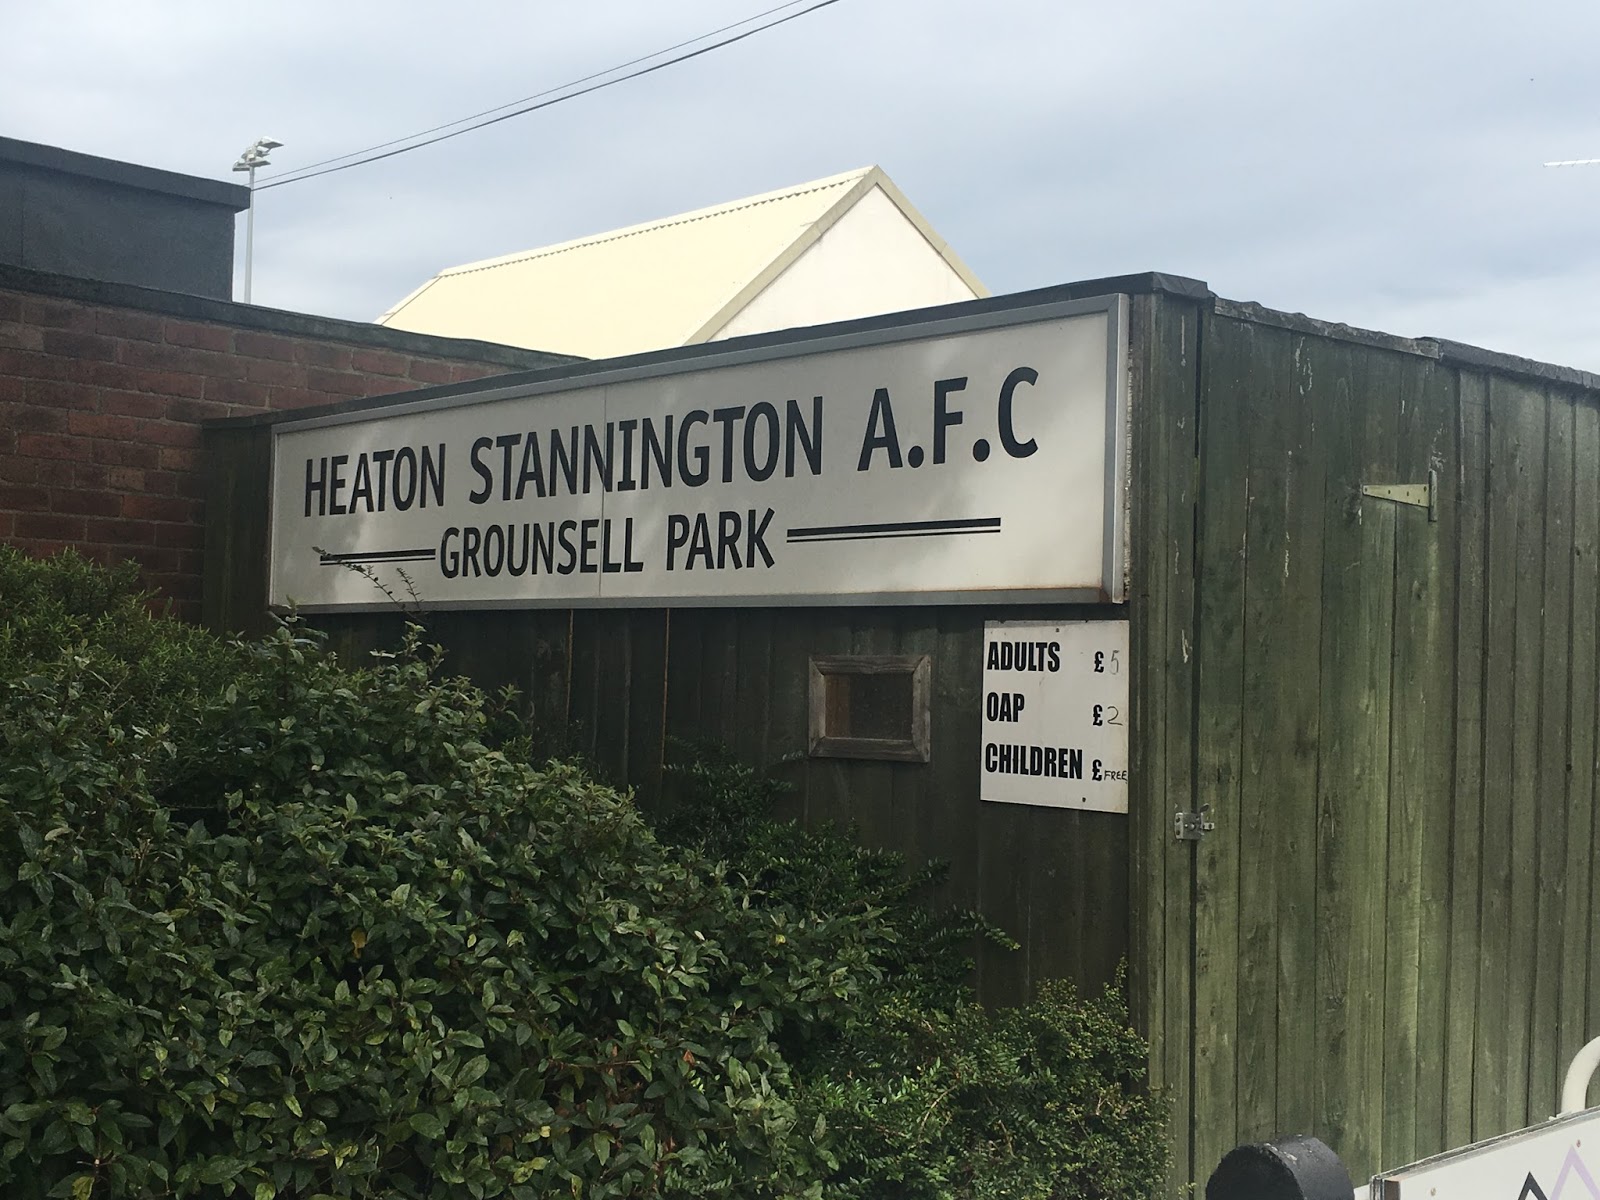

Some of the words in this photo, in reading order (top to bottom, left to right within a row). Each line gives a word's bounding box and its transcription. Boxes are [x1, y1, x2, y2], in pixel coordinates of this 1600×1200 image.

[304, 443, 446, 517] HEATON
[469, 396, 823, 504] STANNINGTON
[857, 366, 1039, 471] A.F.C
[440, 517, 643, 578] GROUNSELL
[666, 507, 775, 571] PARK
[987, 641, 1060, 672] ADULTS
[986, 692, 1025, 722] OAP
[985, 743, 1083, 780] CHILDREN
